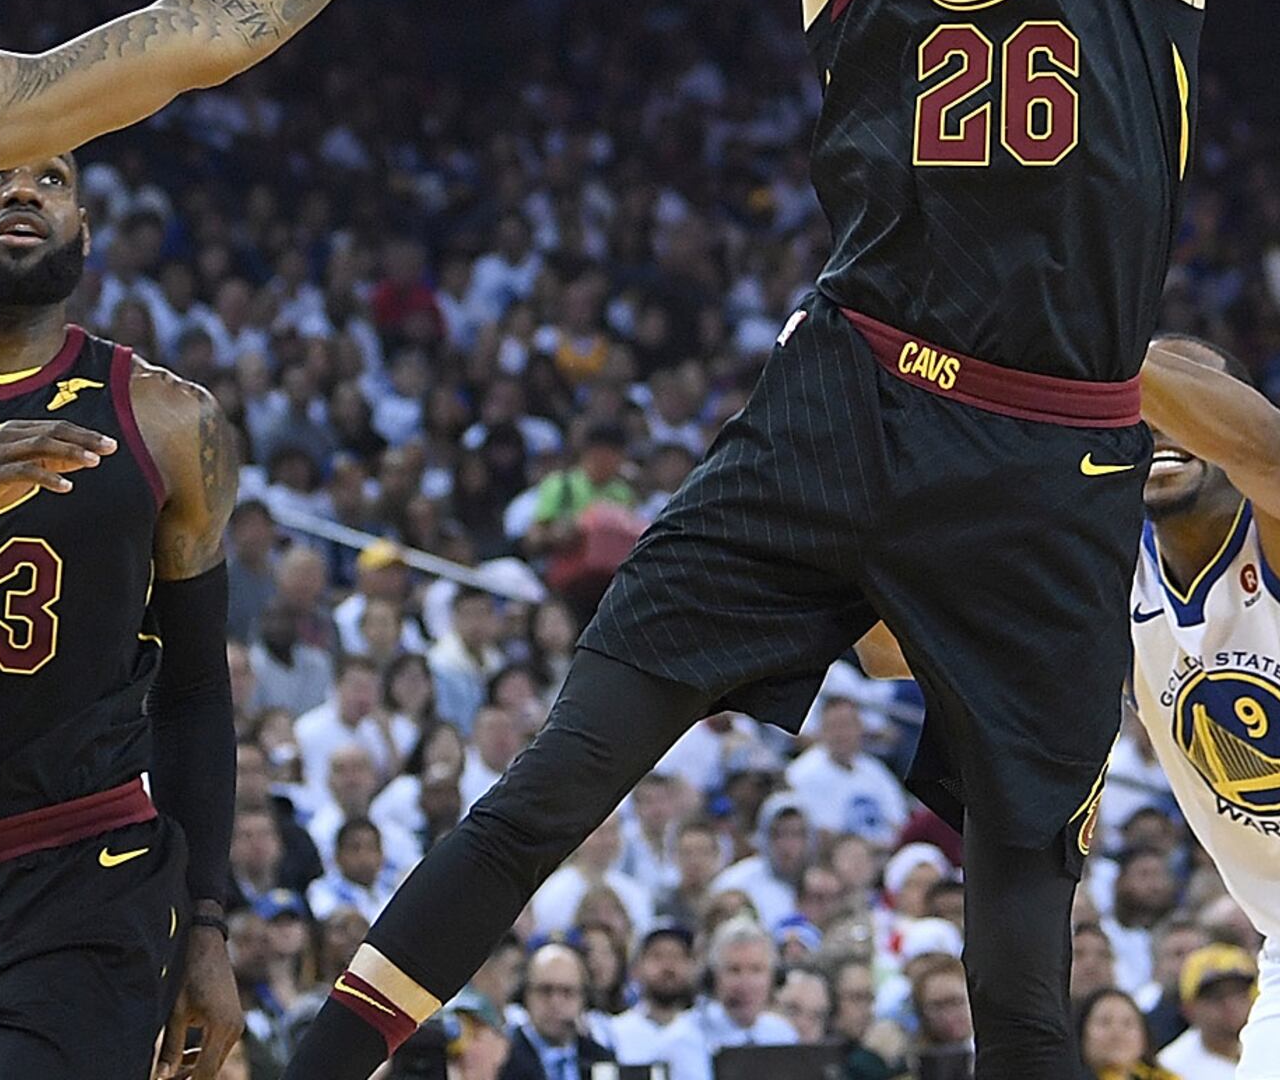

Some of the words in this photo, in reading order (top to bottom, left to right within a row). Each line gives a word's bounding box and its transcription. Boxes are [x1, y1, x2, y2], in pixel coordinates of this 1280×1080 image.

[912, 19, 1080, 167] 26
[898, 341, 961, 390] CAVS
[1233, 697, 1269, 739] 9
